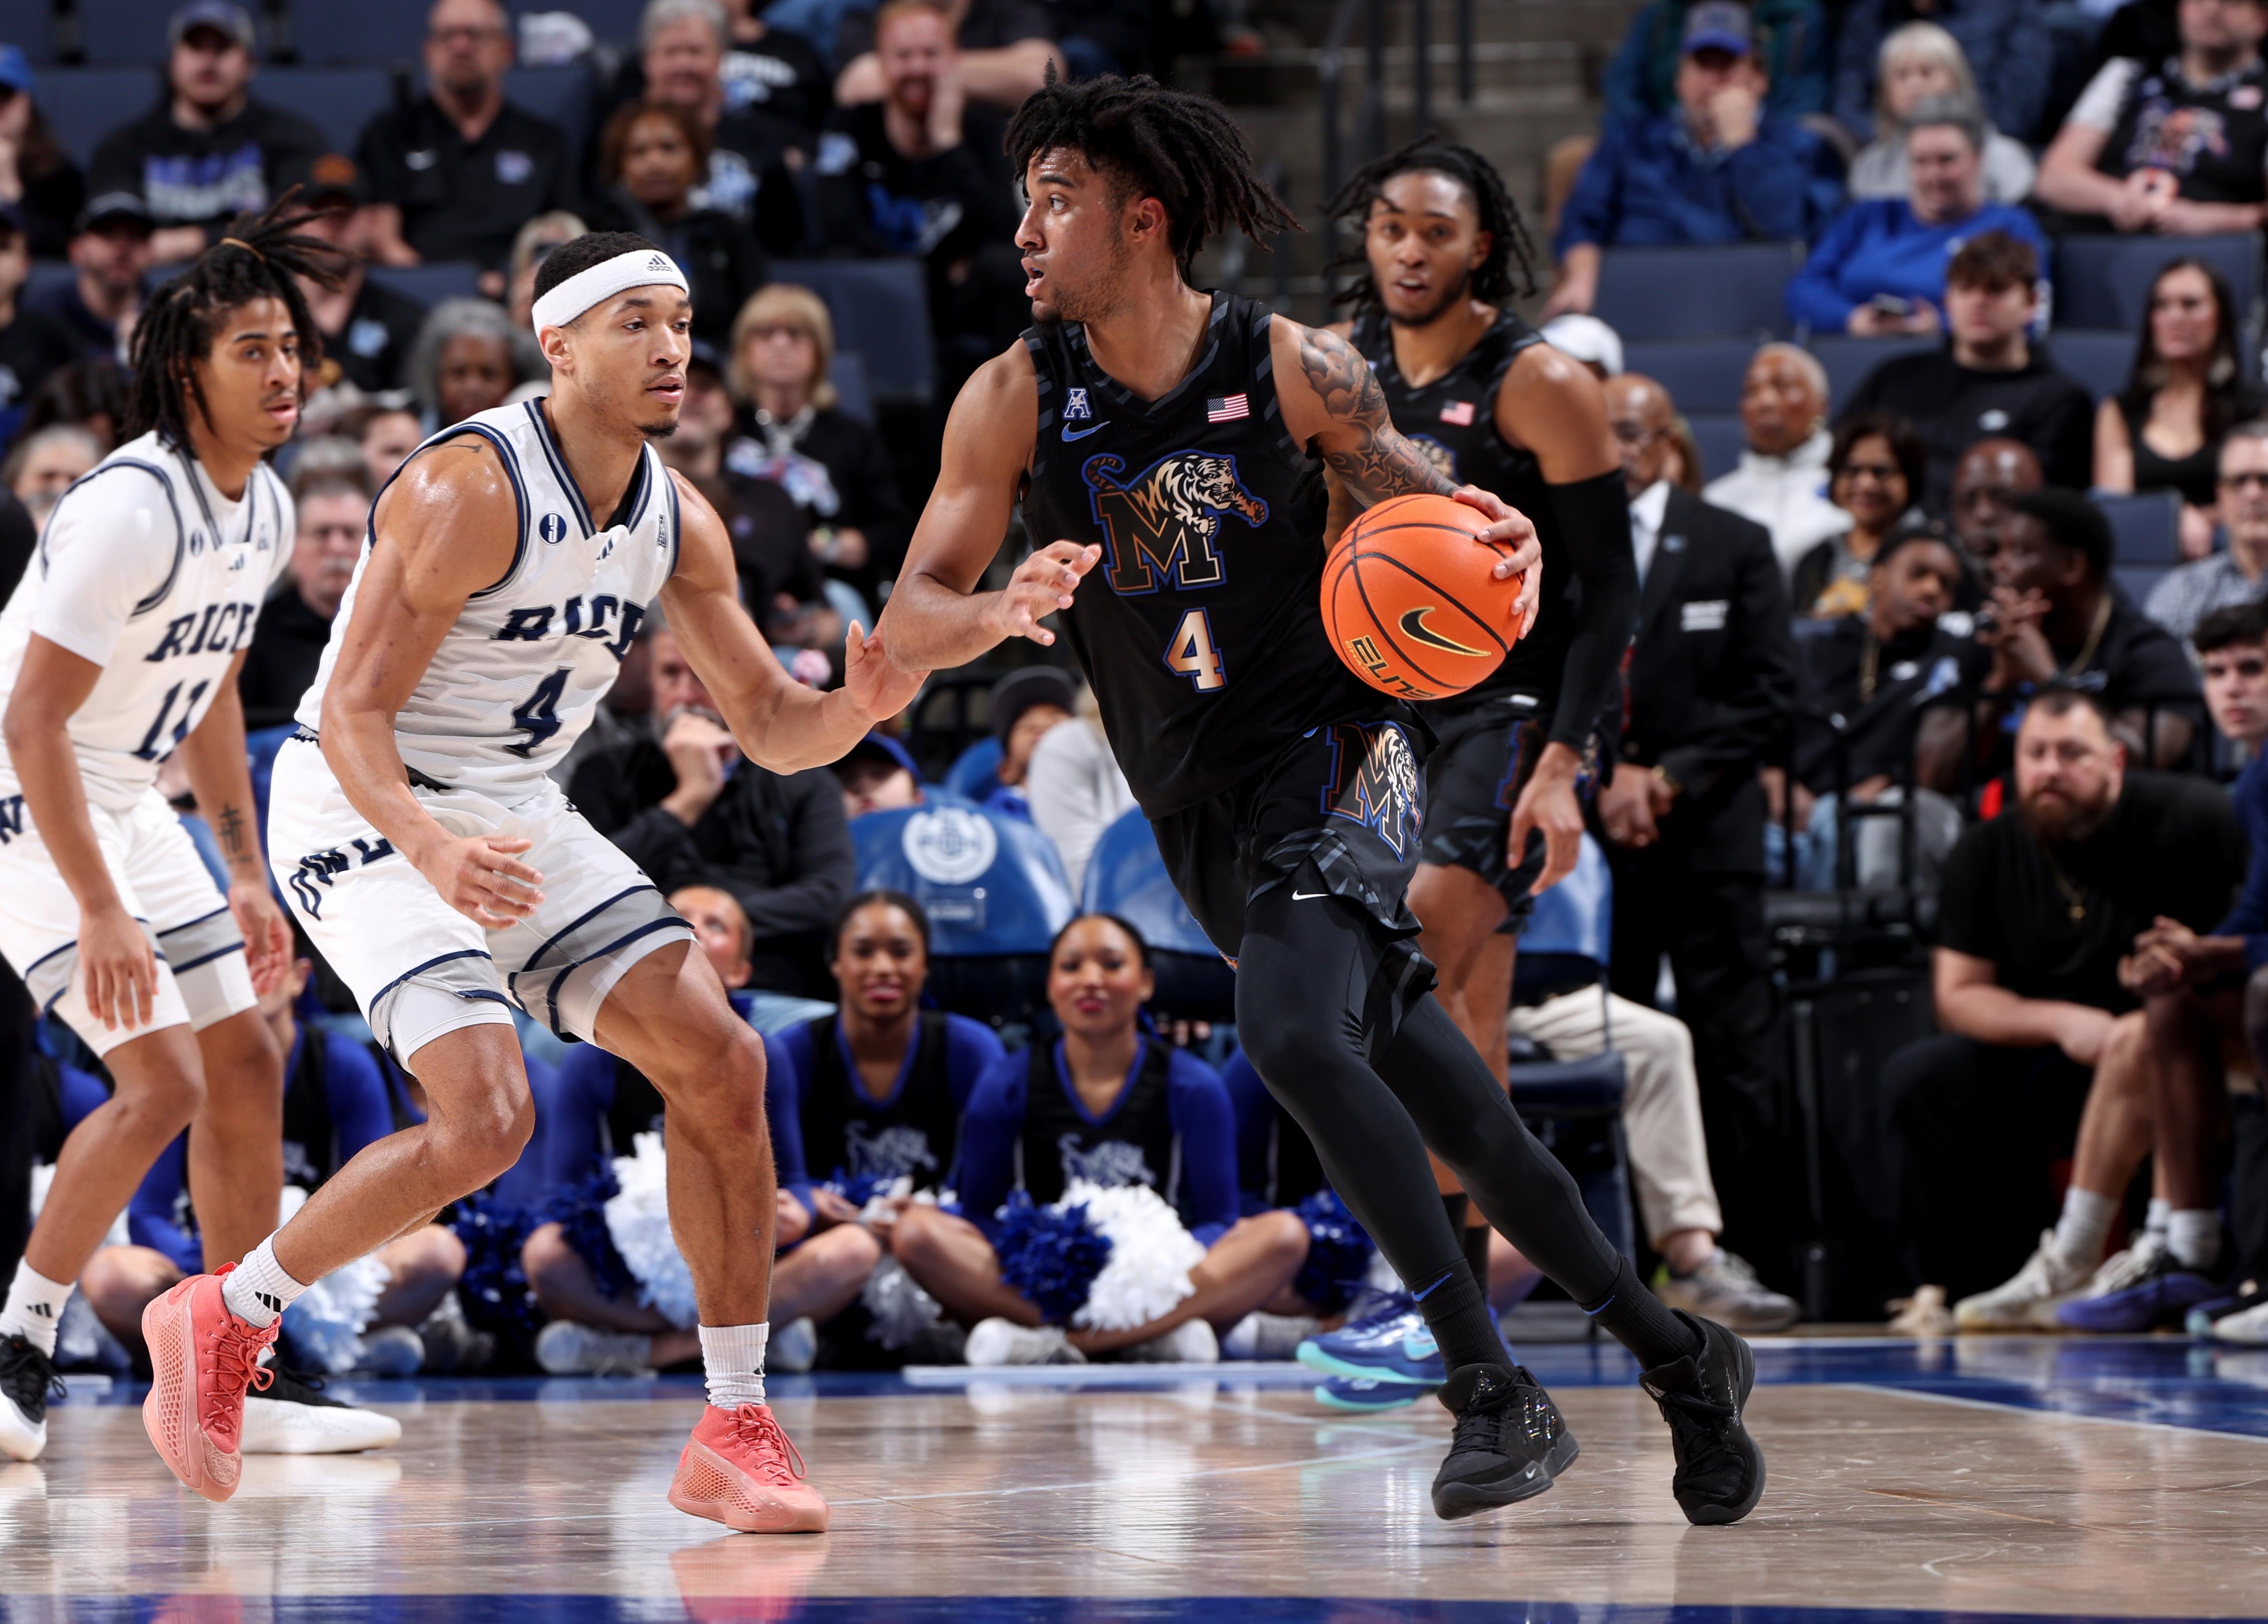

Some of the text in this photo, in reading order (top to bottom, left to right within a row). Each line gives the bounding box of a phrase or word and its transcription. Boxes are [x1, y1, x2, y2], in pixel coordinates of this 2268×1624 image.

[1063, 388, 1092, 420] A
[143, 602, 255, 662] RICE
[490, 593, 646, 664] RICE
[1163, 606, 1228, 693] 4
[1350, 634, 1438, 699] ELITE
[129, 679, 211, 764] 11
[502, 665, 575, 758] 4
[289, 838, 397, 921] OWL
